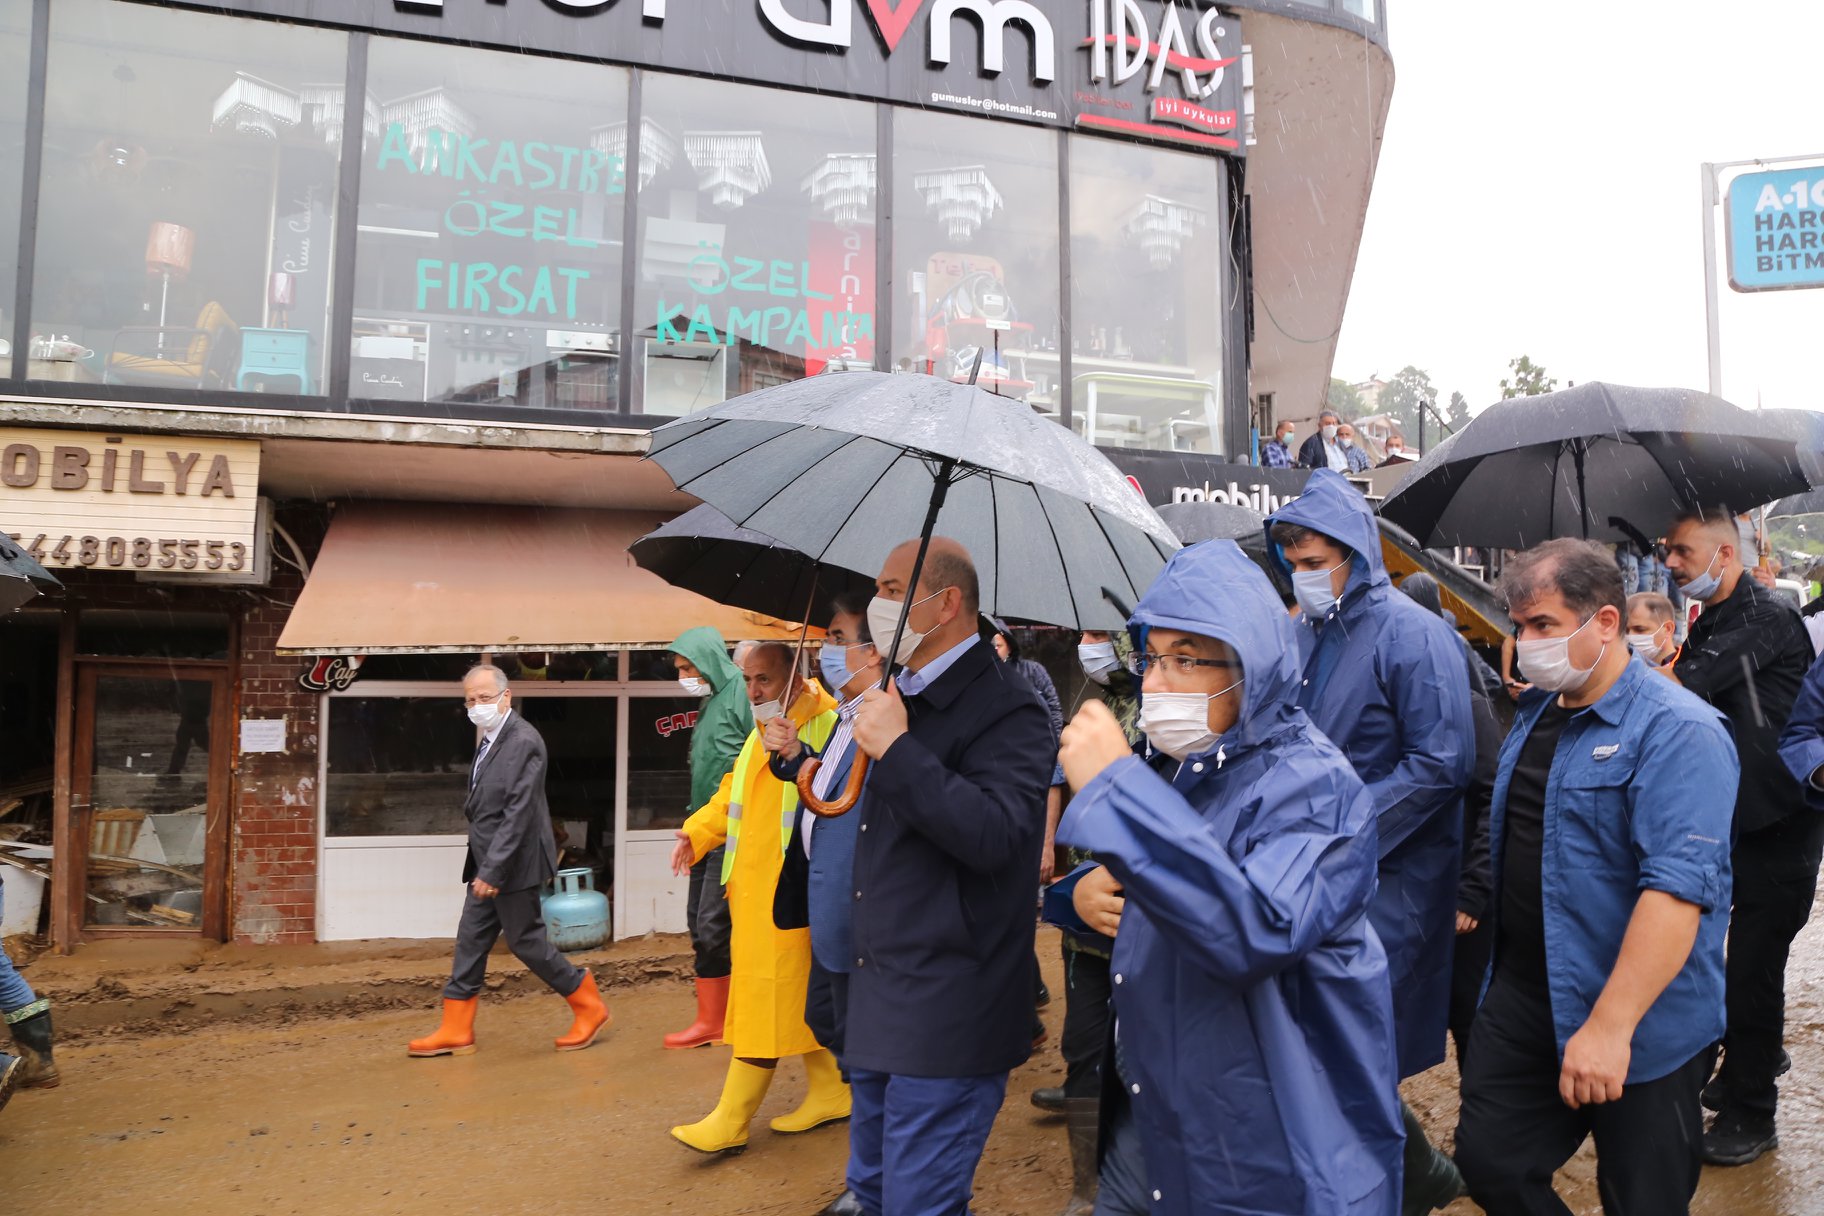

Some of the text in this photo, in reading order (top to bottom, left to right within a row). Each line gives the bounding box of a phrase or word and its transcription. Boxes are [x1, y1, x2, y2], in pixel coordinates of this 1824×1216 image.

[931, 91, 1057, 119] gumusler@hotmail.com
[1183, 106, 1231, 125] uykular
[444, 189, 599, 248] ÖZEL
[1755, 210, 1824, 232] HAR
[1756, 231, 1824, 253] HAR
[687, 240, 834, 301] ÖZEL
[416, 258, 590, 319] FIRSAT
[7, 533, 247, 571] 448085553
